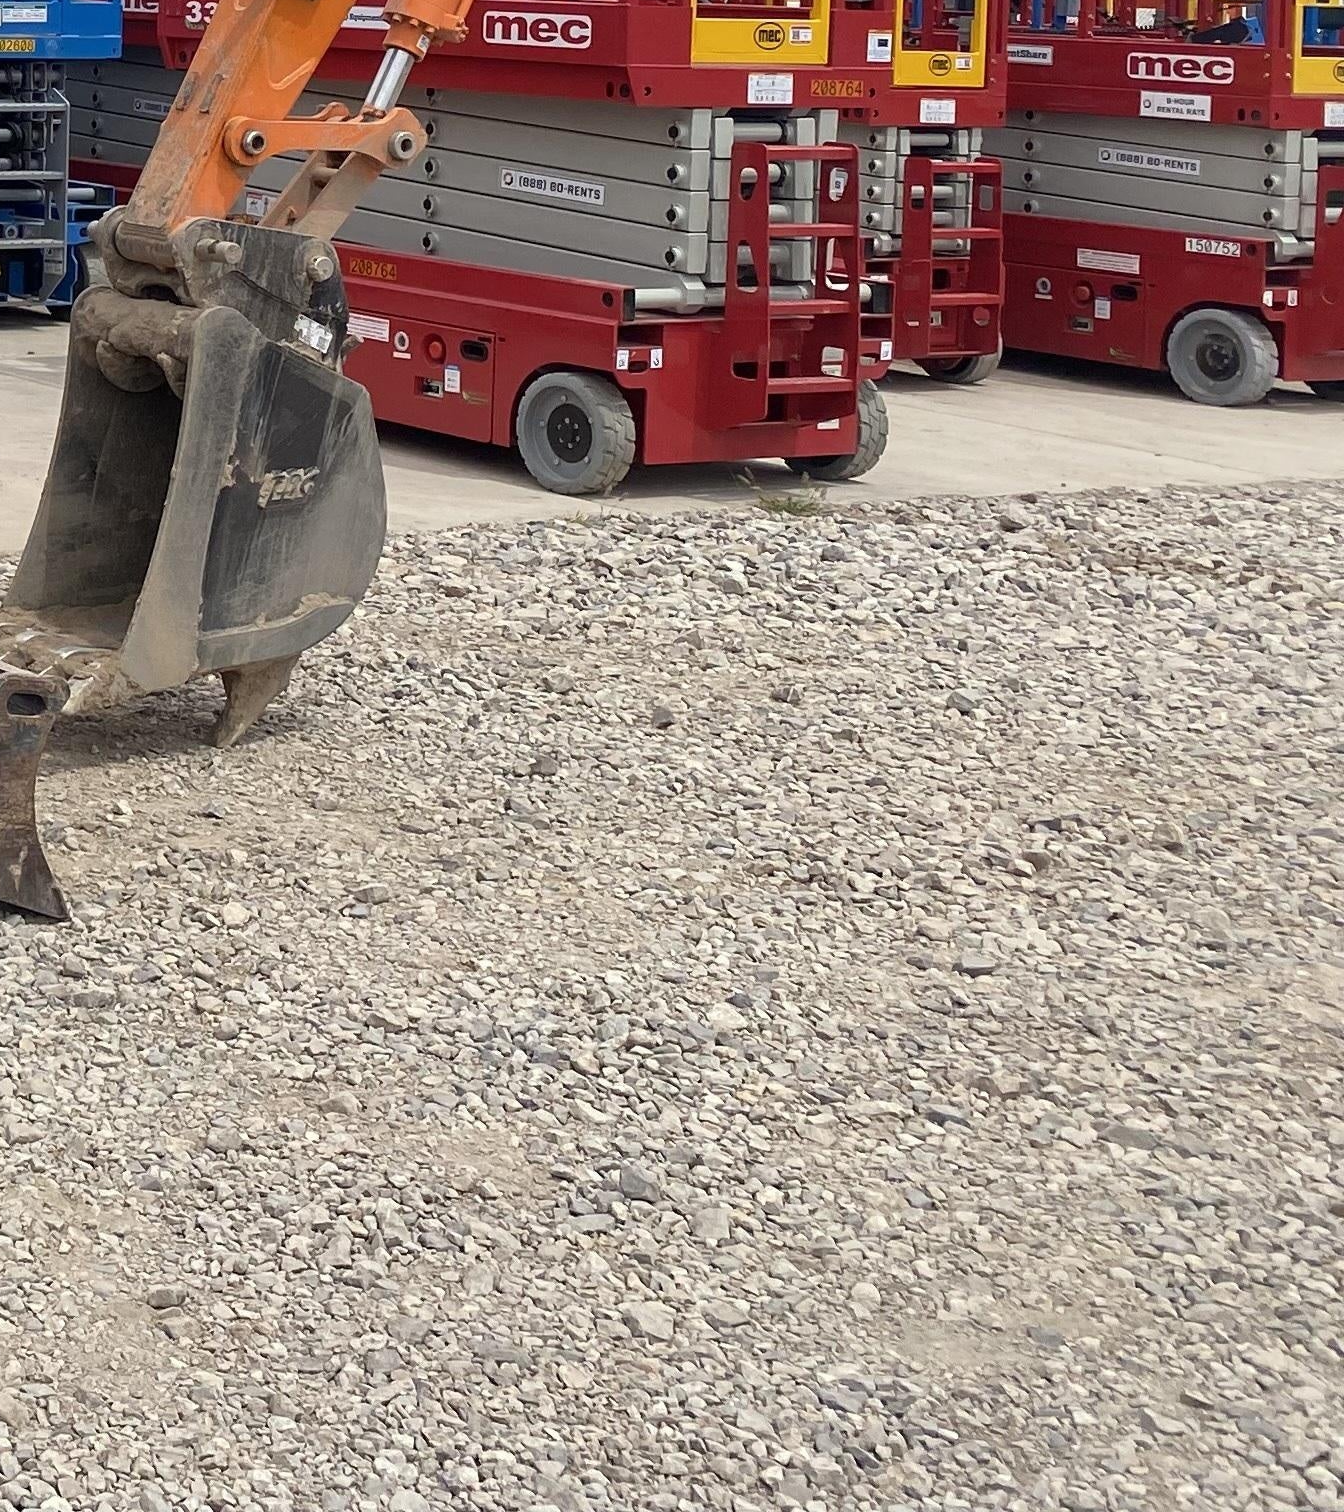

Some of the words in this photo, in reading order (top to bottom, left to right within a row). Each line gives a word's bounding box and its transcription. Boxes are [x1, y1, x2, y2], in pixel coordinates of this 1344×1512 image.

[486, 15, 590, 44] mec
[758, 29, 781, 43] mec
[1129, 55, 1232, 80] mec
[812, 80, 862, 96] 208764
[1187, 239, 1240, 256] 150752
[351, 259, 396, 279] 208764
